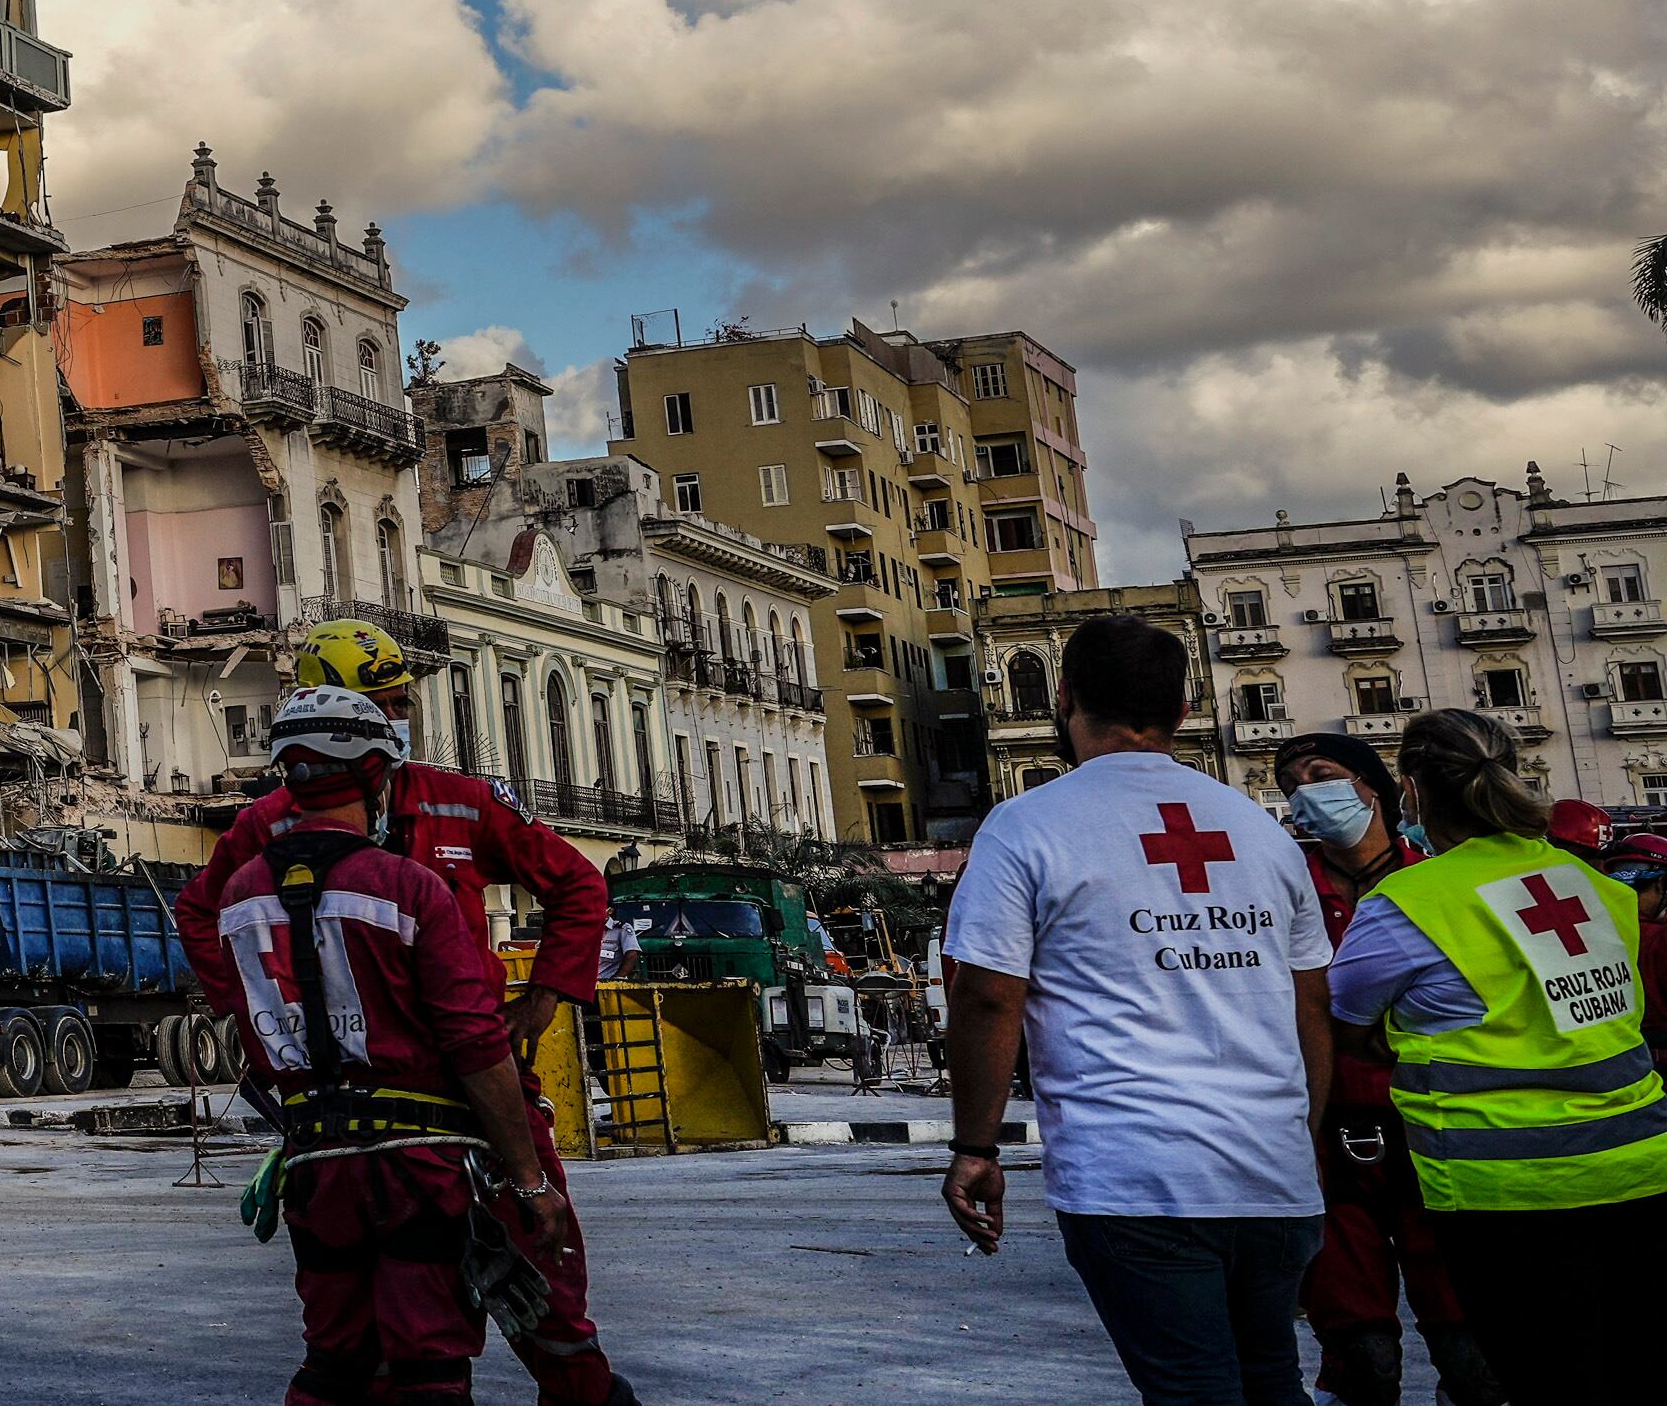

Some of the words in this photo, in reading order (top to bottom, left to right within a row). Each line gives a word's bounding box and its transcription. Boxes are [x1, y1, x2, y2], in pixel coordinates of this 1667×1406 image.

[1129, 909, 1201, 934] Cruz
[1204, 904, 1274, 935] Roja
[1154, 946, 1261, 971] Cubana
[1545, 970, 1594, 1002] CRUZ
[1589, 961, 1632, 991] ROJA
[328, 1005, 365, 1041] oja
[1569, 989, 1628, 1024] CUBANA
